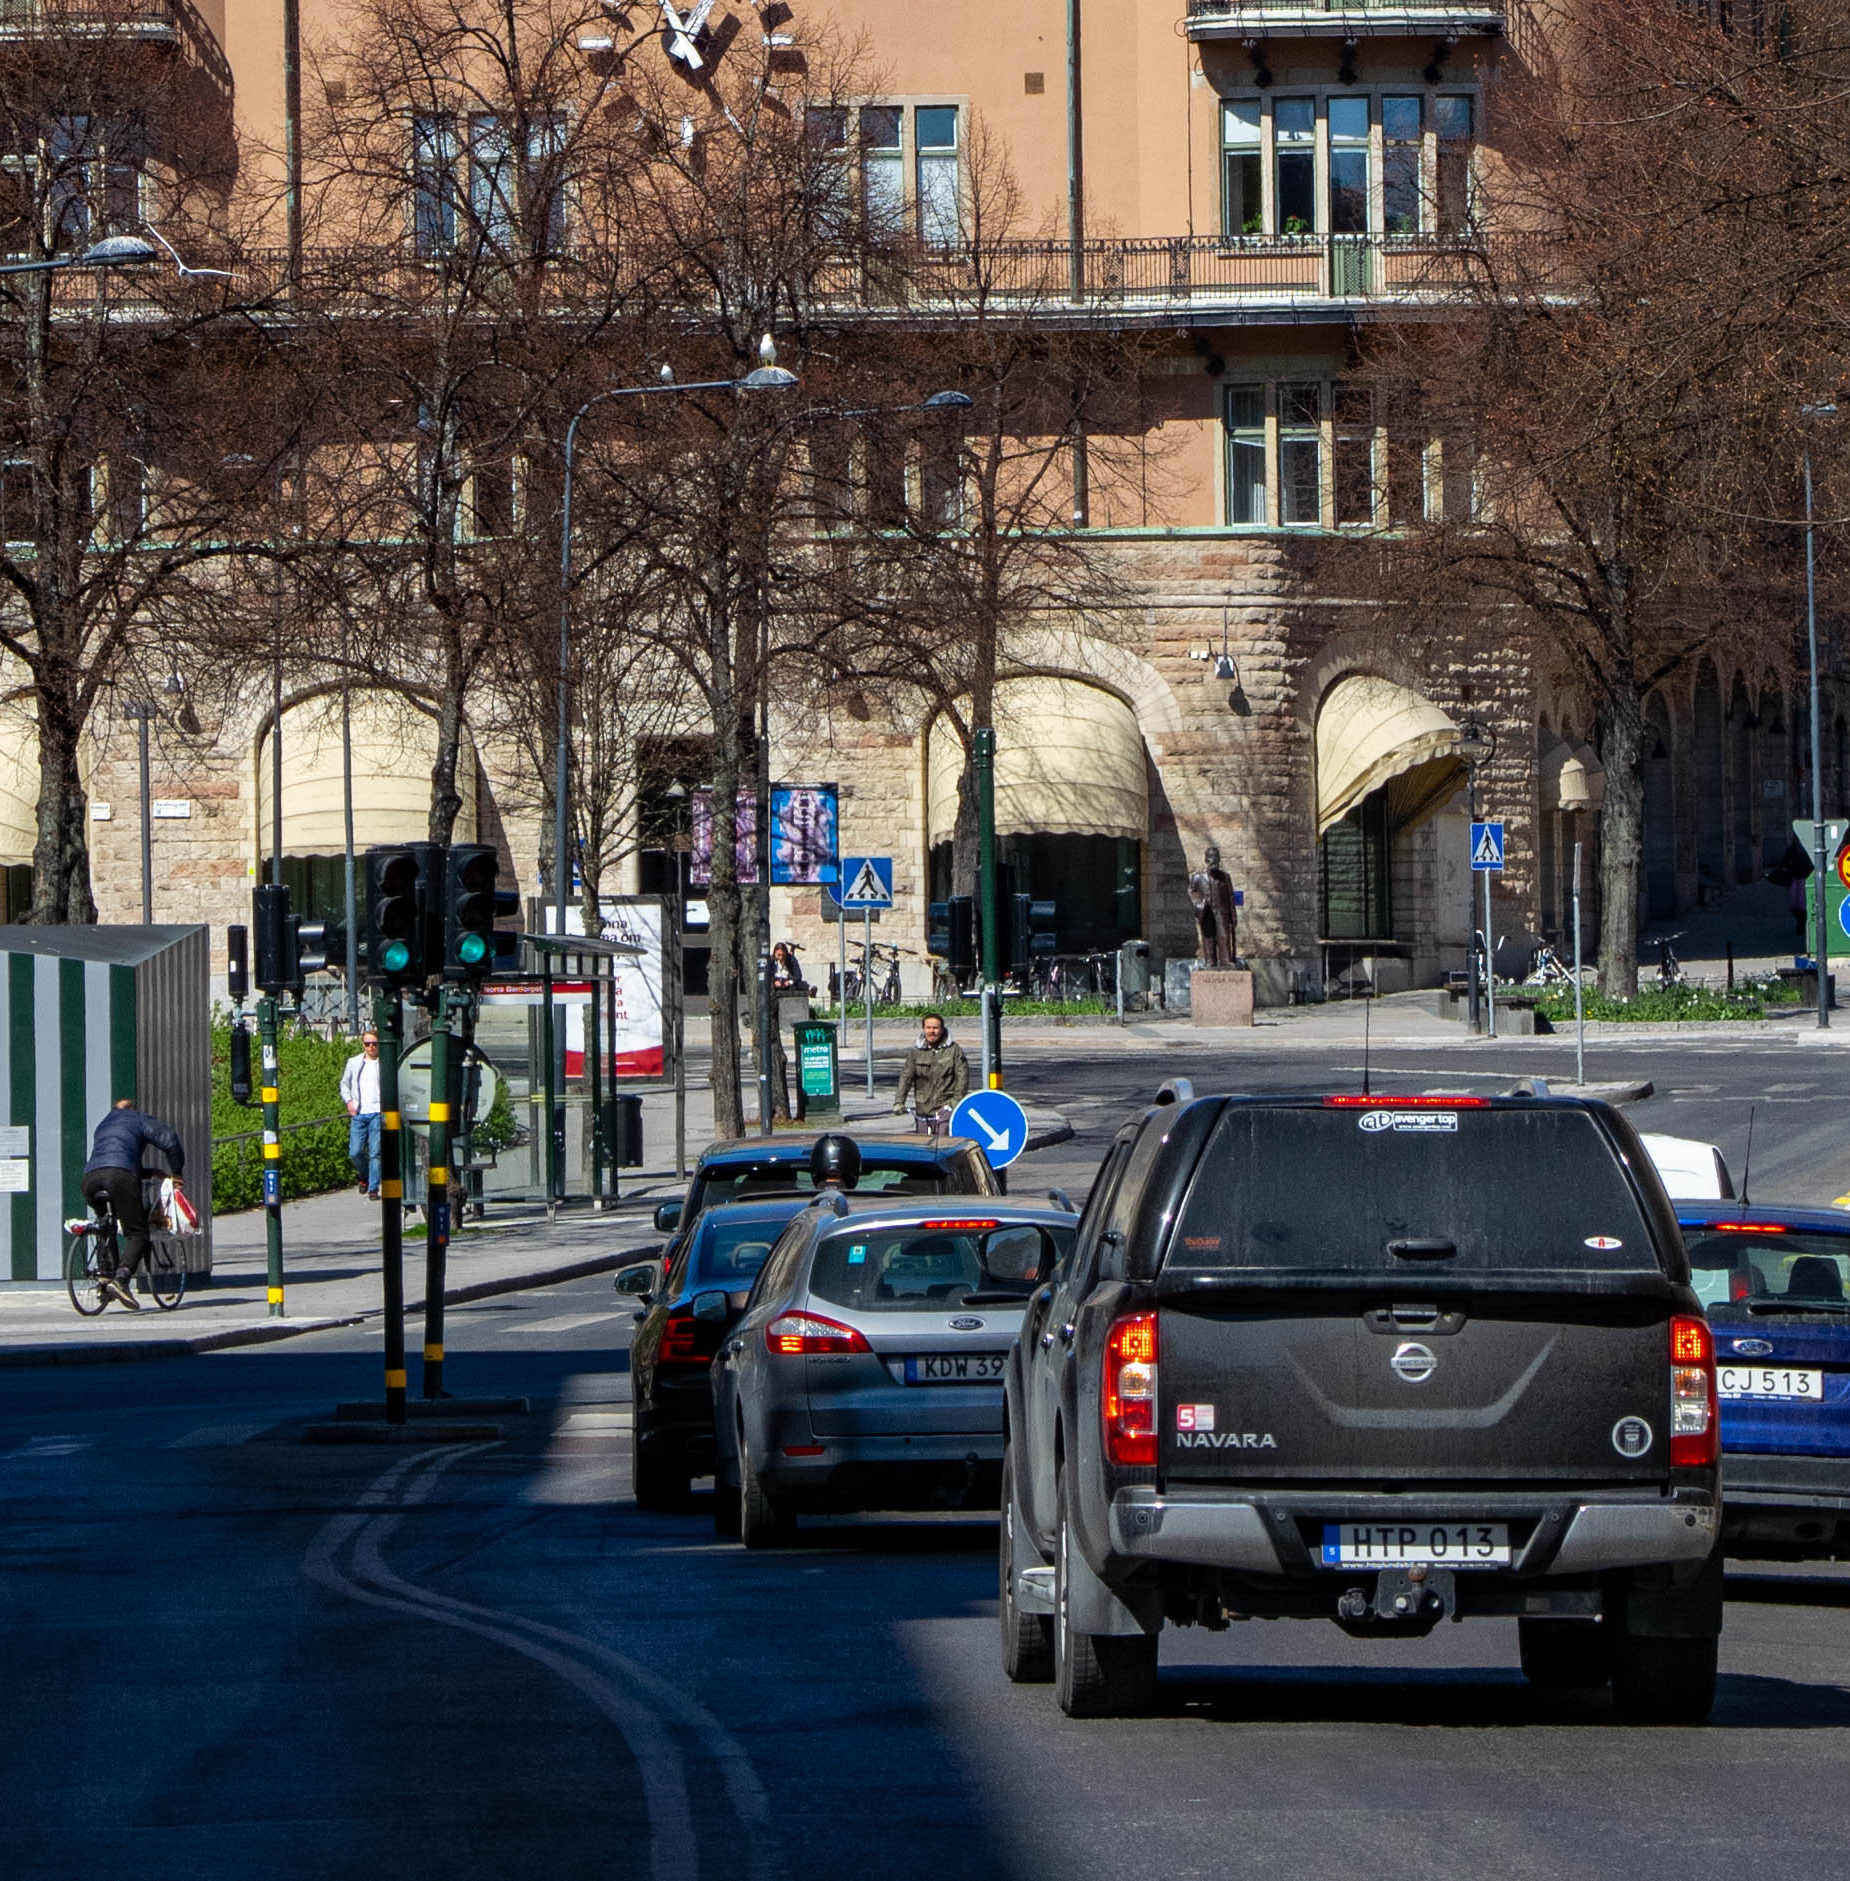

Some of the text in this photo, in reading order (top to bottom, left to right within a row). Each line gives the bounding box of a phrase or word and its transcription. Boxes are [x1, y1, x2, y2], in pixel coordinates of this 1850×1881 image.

[1395, 1115, 1436, 1126] avenger
[1438, 1114, 1456, 1125] top
[925, 1356, 1004, 1378] KDW 39
[1722, 1369, 1810, 1393] CJ 513
[1179, 1408, 1194, 1427] 5
[1176, 1433, 1278, 1449] NAVARA
[1353, 1527, 1416, 1558] HTP
[1429, 1527, 1494, 1558] 013
